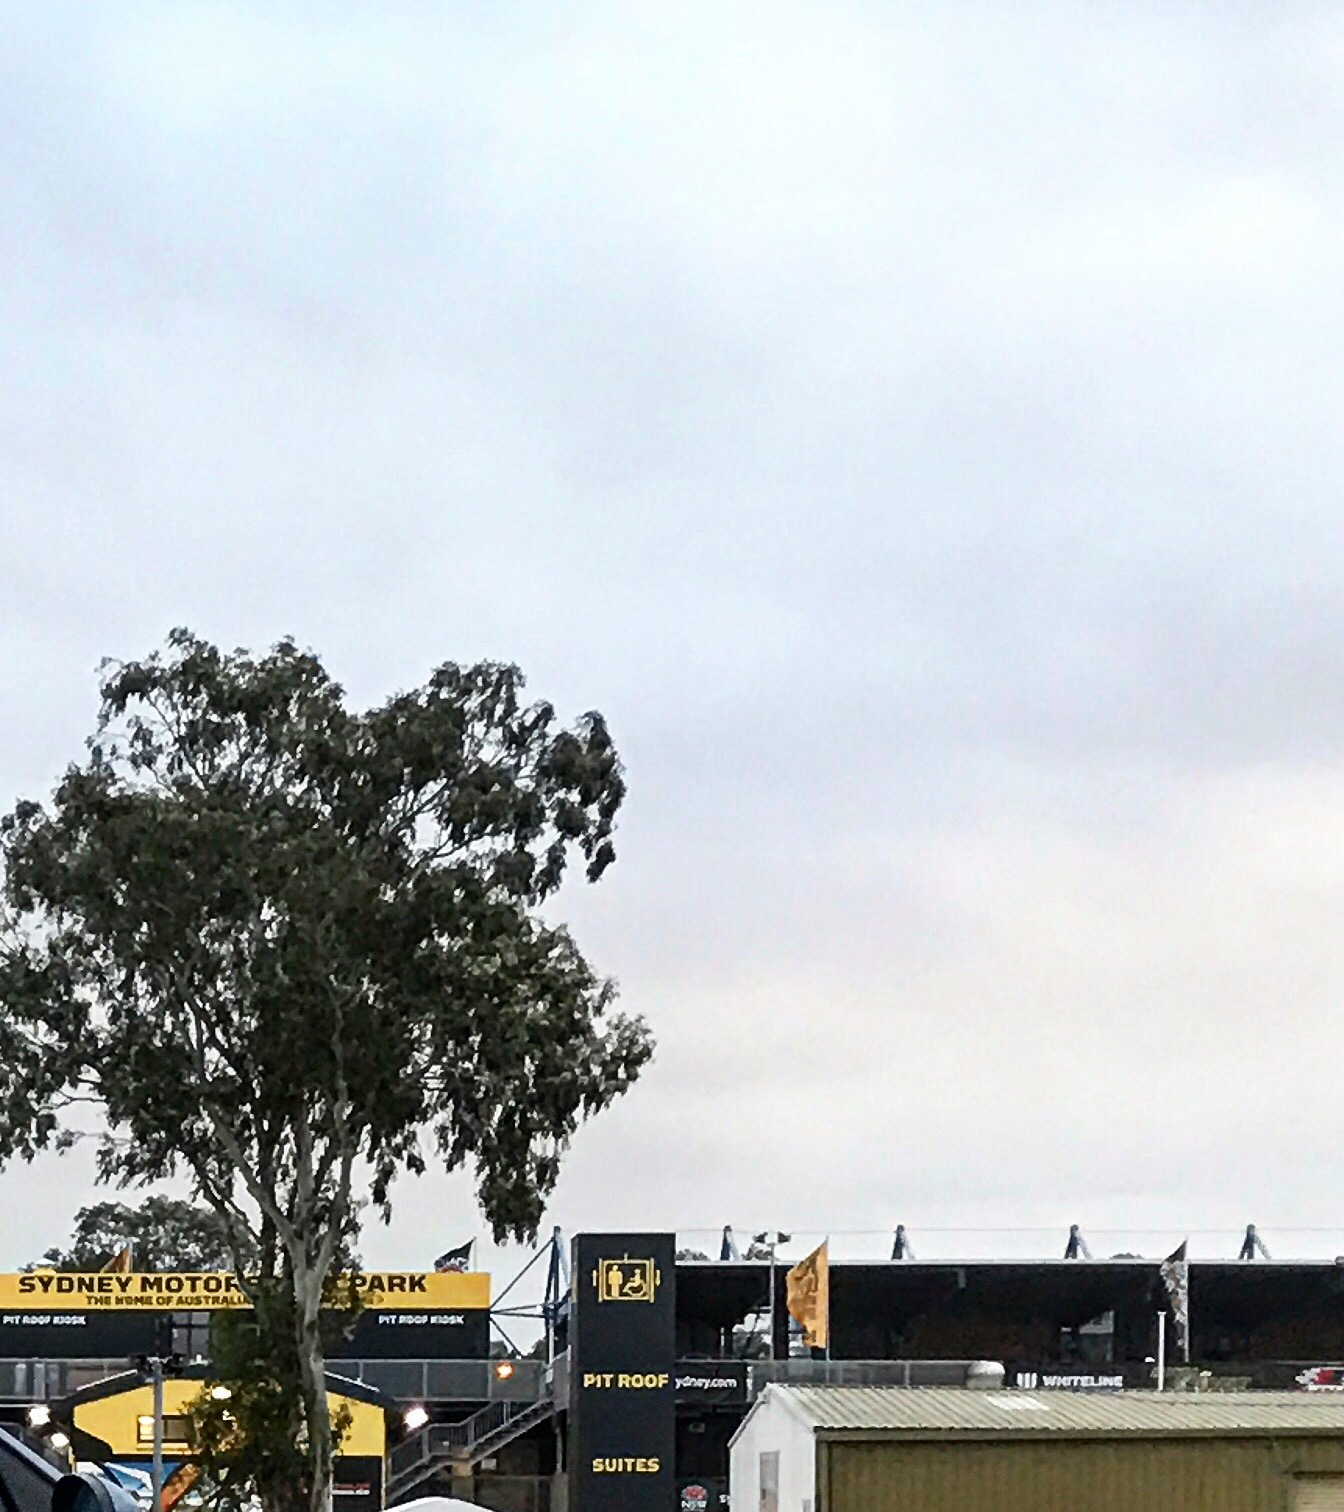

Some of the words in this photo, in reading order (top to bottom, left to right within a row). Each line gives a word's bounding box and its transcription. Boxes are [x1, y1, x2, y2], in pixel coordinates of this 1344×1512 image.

[18, 1275, 132, 1294] SYDNEY
[354, 1274, 427, 1293] PARK
[86, 1295, 112, 1307] THE
[156, 1295, 174, 1307] OF
[2, 1314, 21, 1325] PIT
[378, 1314, 397, 1325] PIT
[583, 1373, 614, 1388] PIT
[617, 1373, 669, 1388] ROOF
[675, 1375, 737, 1389] ydney.com
[1042, 1374, 1124, 1388] WHITELINE
[592, 1457, 660, 1473] SUITES
